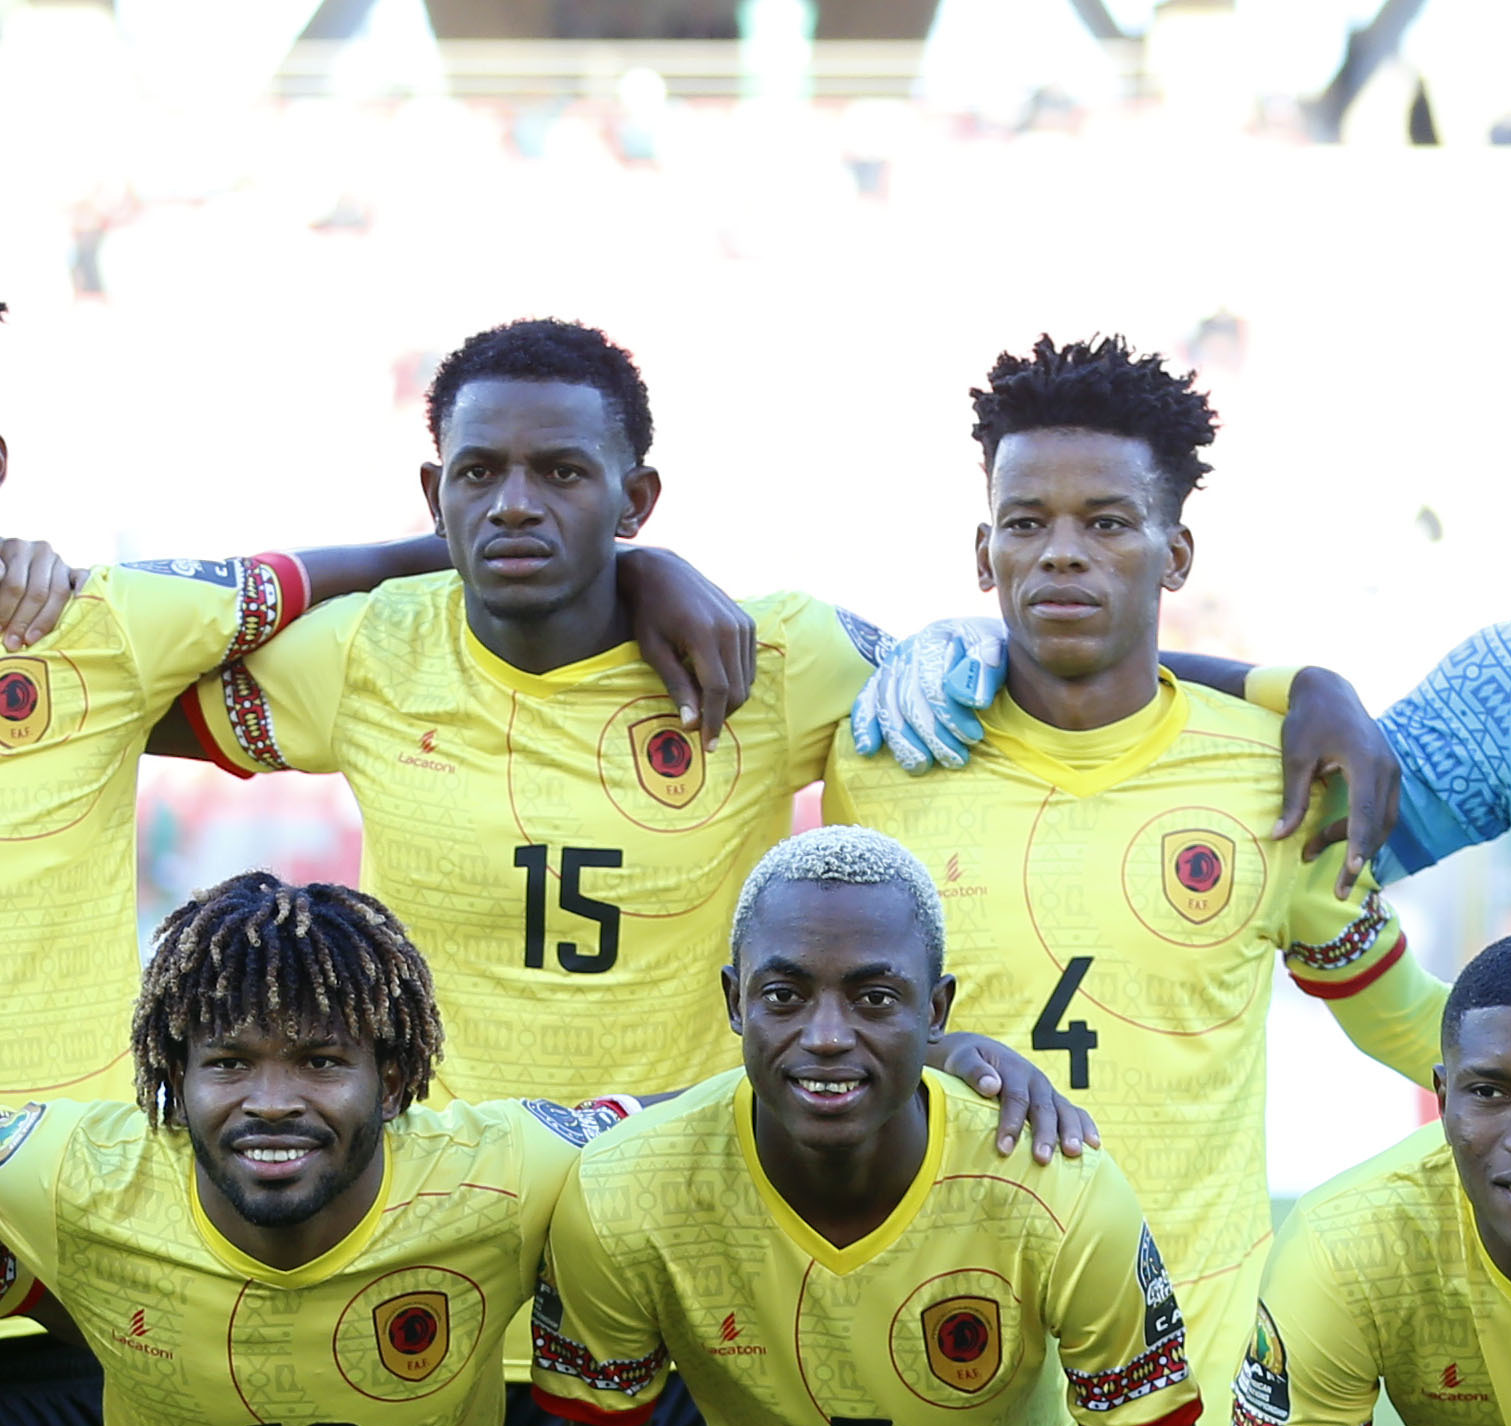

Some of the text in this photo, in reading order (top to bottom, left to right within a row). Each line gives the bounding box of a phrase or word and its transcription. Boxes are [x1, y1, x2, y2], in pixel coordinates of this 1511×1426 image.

[397, 752, 456, 774] Lacatoni
[938, 886, 988, 898] catoni
[513, 844, 623, 974] 15
[1031, 957, 1098, 1090] 4
[112, 1328, 174, 1361] Lacatoni
